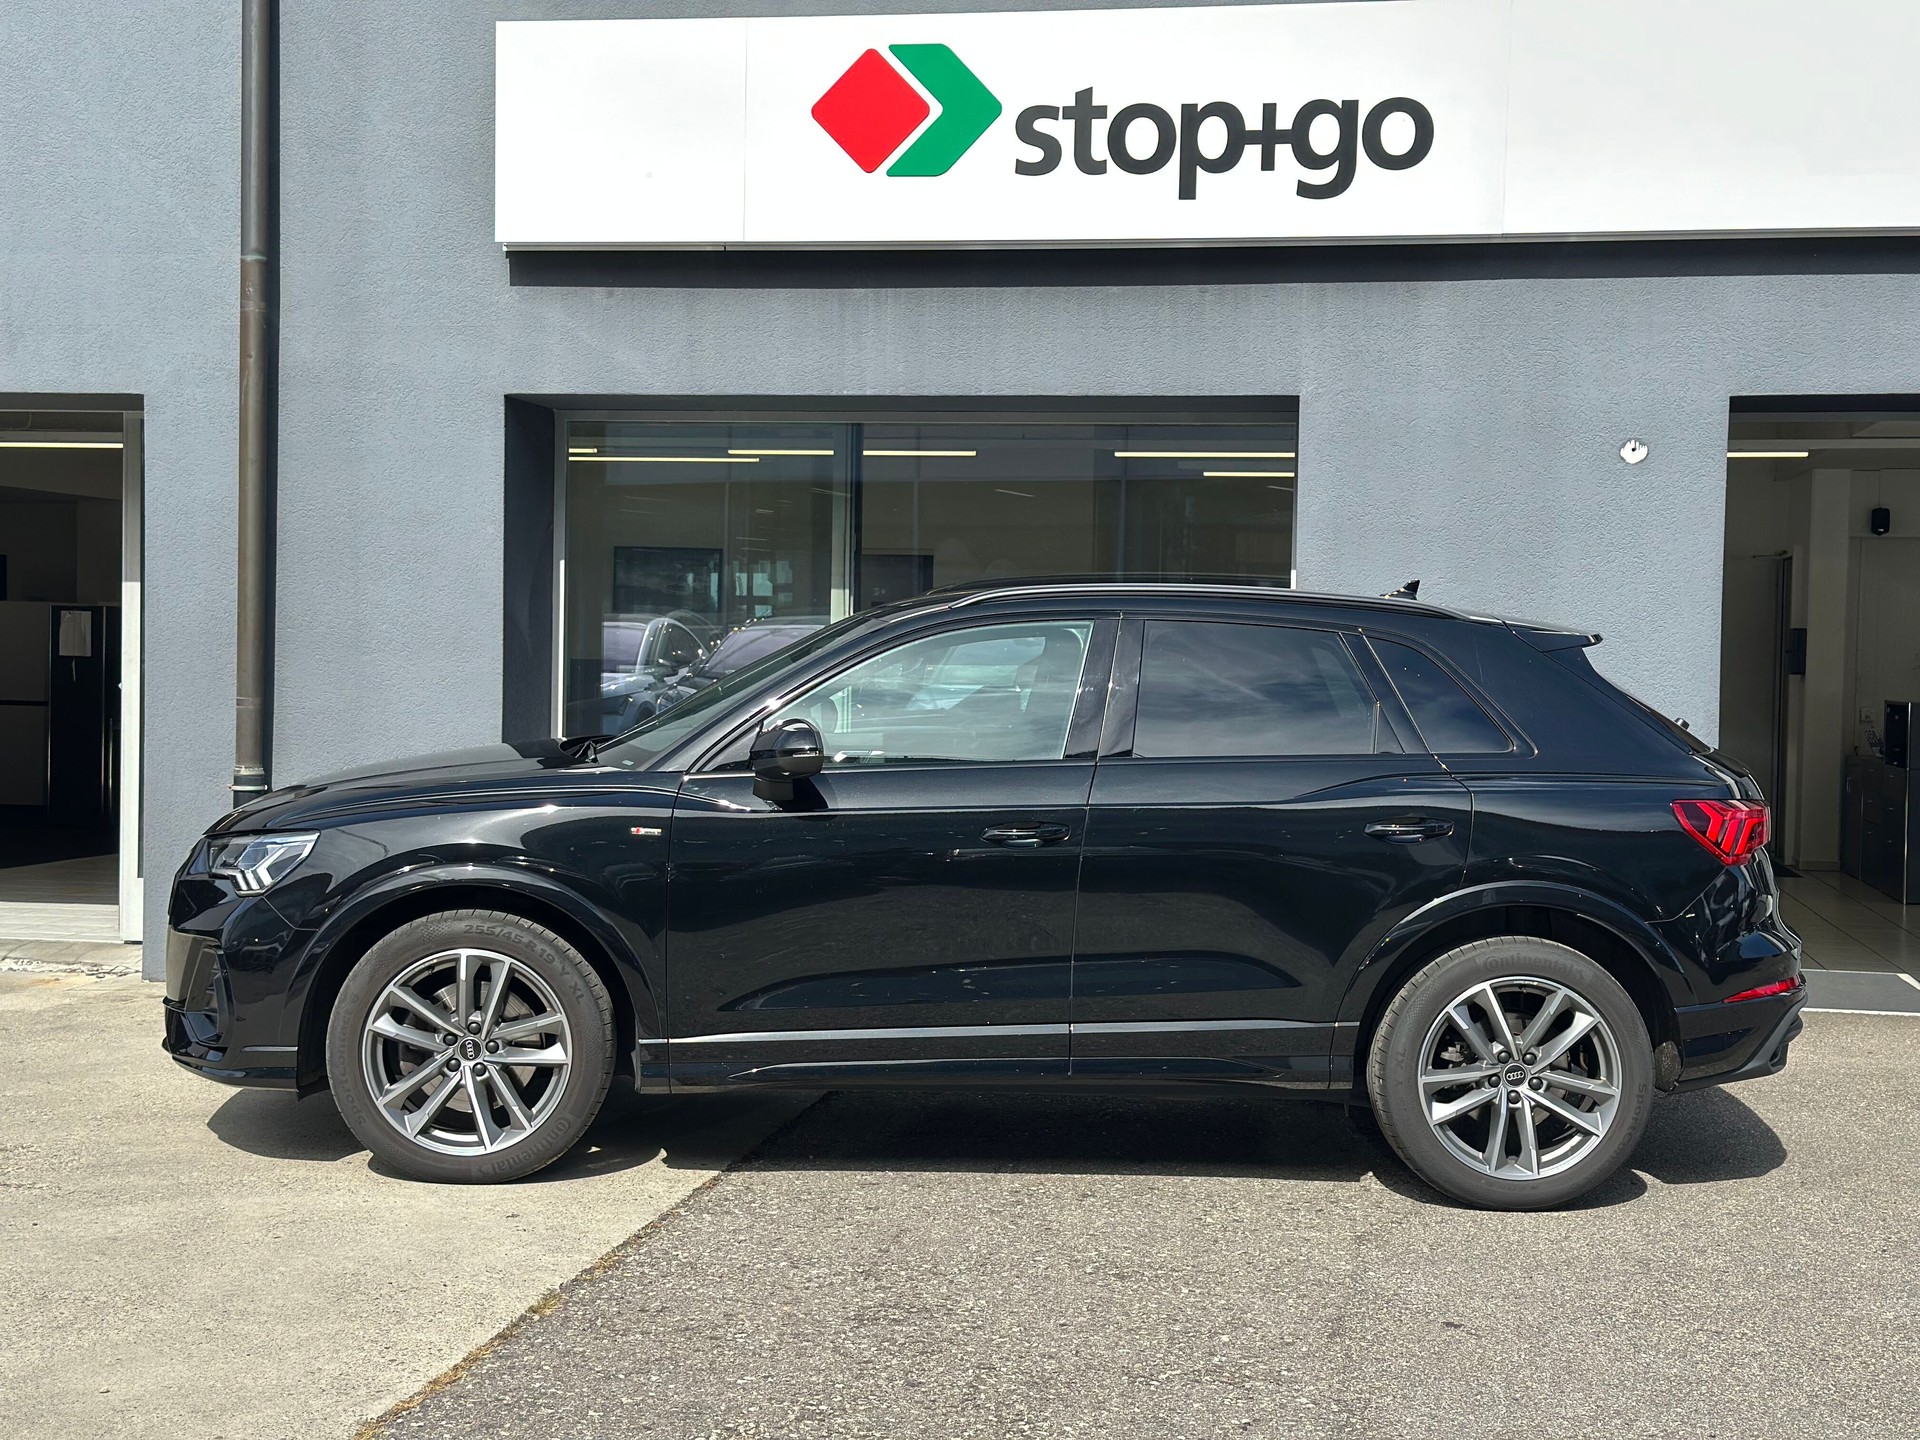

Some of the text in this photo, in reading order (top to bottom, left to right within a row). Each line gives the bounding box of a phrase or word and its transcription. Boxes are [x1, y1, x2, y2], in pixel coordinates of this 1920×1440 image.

[1015, 86, 1434, 200] stop+go
[464, 924, 524, 944] 255/45
[525, 941, 538, 952] R
[540, 948, 556, 965] 19
[492, 1118, 572, 1173] Continental
